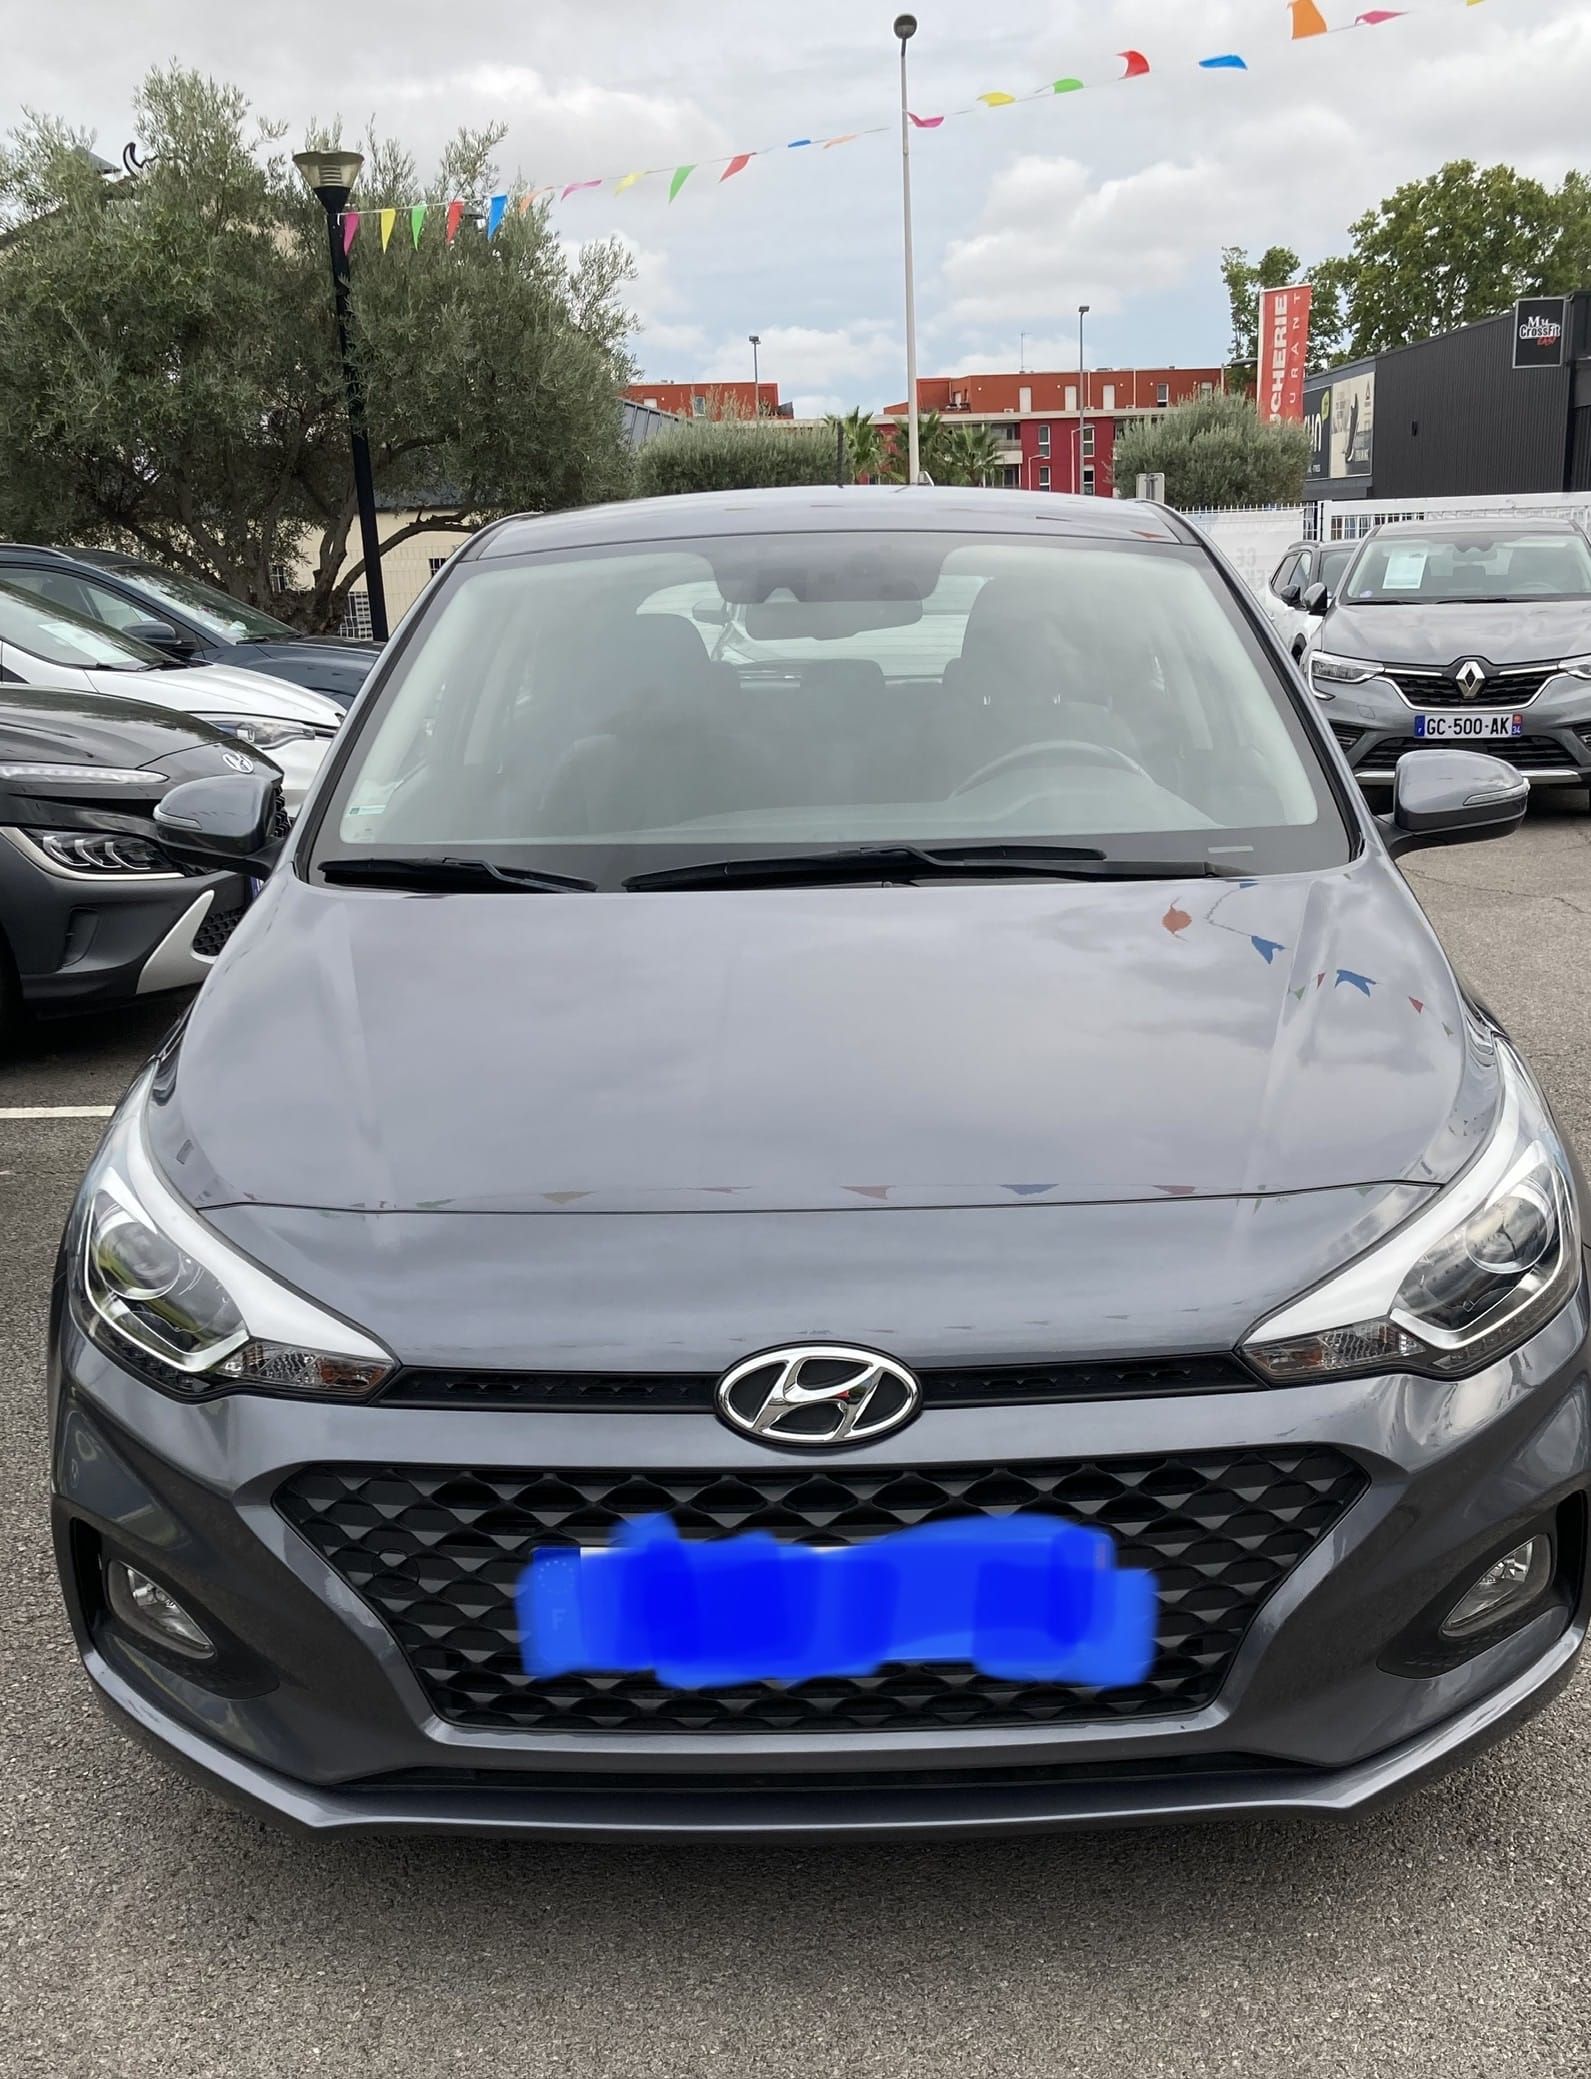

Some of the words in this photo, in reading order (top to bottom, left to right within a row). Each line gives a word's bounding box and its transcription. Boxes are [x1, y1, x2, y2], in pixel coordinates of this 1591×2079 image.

[1520, 325, 1560, 338] CrossFit
[1288, 293, 1301, 421] URANT
[1426, 717, 1510, 735] GC-500-AK
